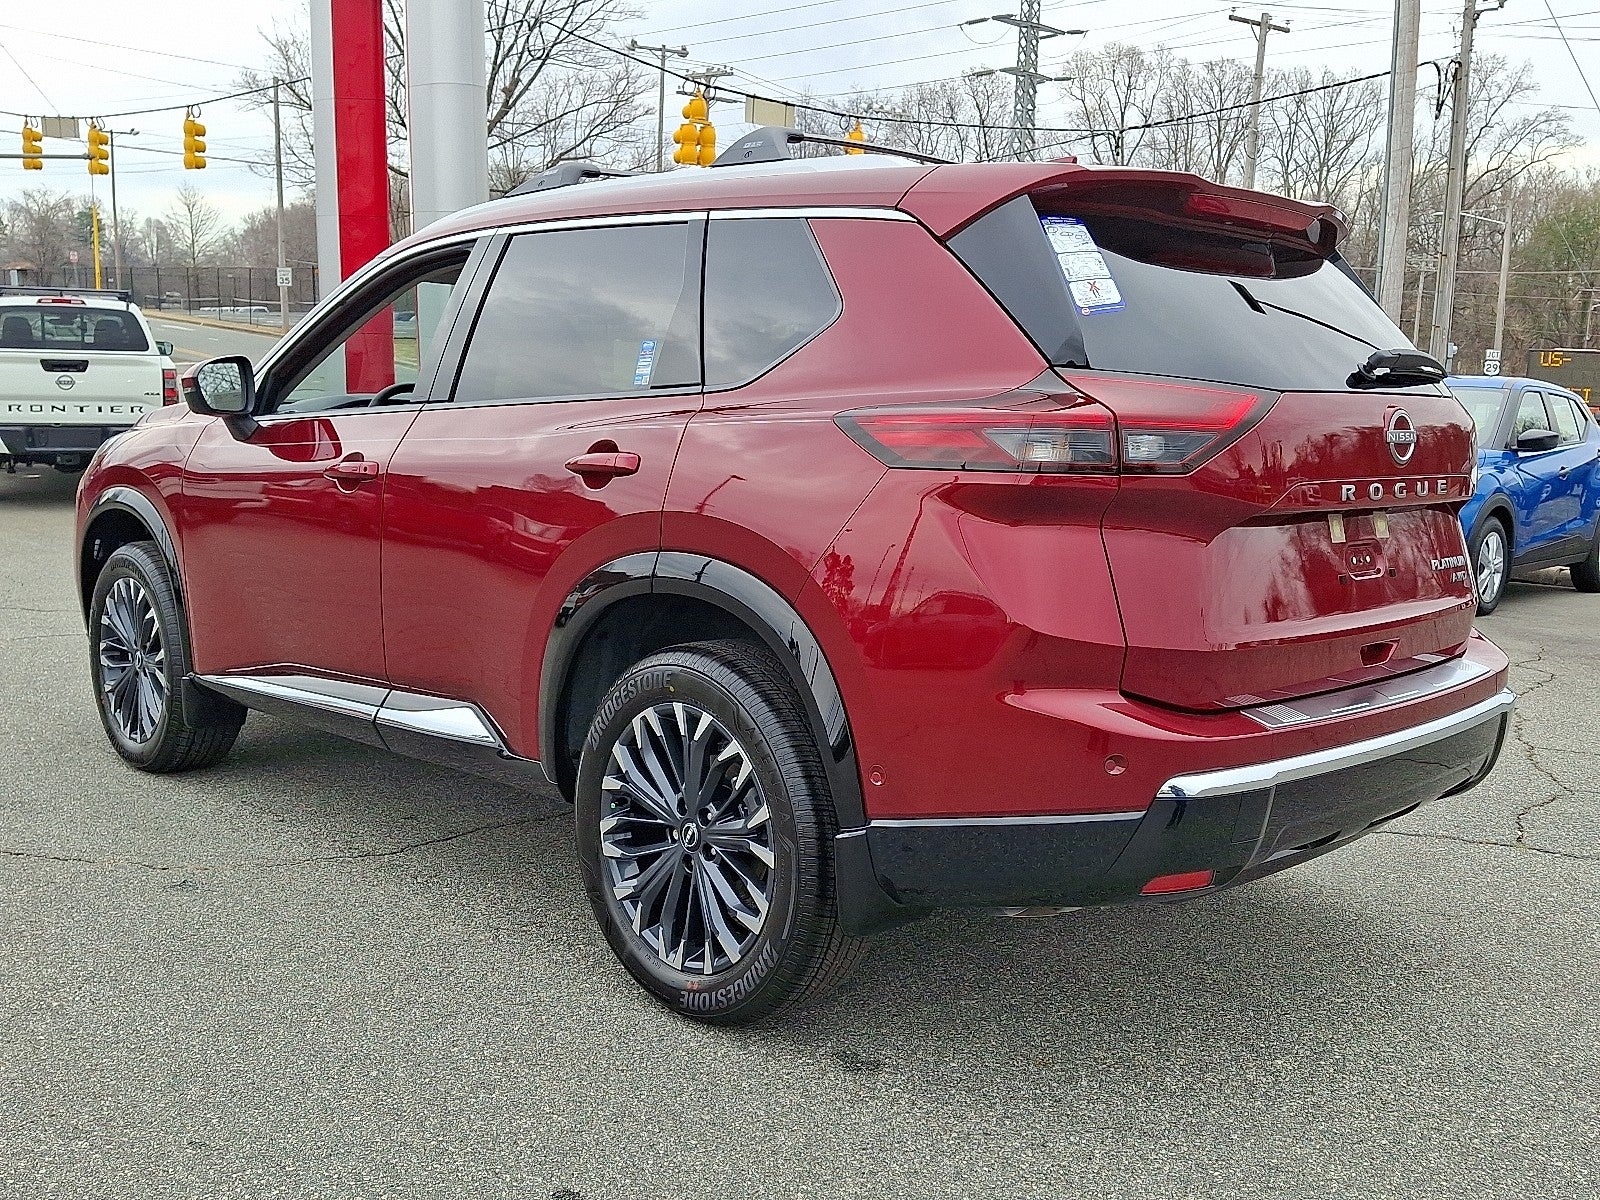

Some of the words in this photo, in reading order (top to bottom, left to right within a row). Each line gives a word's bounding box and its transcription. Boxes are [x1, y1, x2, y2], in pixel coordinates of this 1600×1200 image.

[280, 276, 290, 285] 35
[1486, 364, 1498, 372] 29
[1341, 479, 1447, 501] ROGUE
[587, 670, 672, 751] BRIDGESTONE
[679, 938, 779, 1011] BRIDGESTONE
